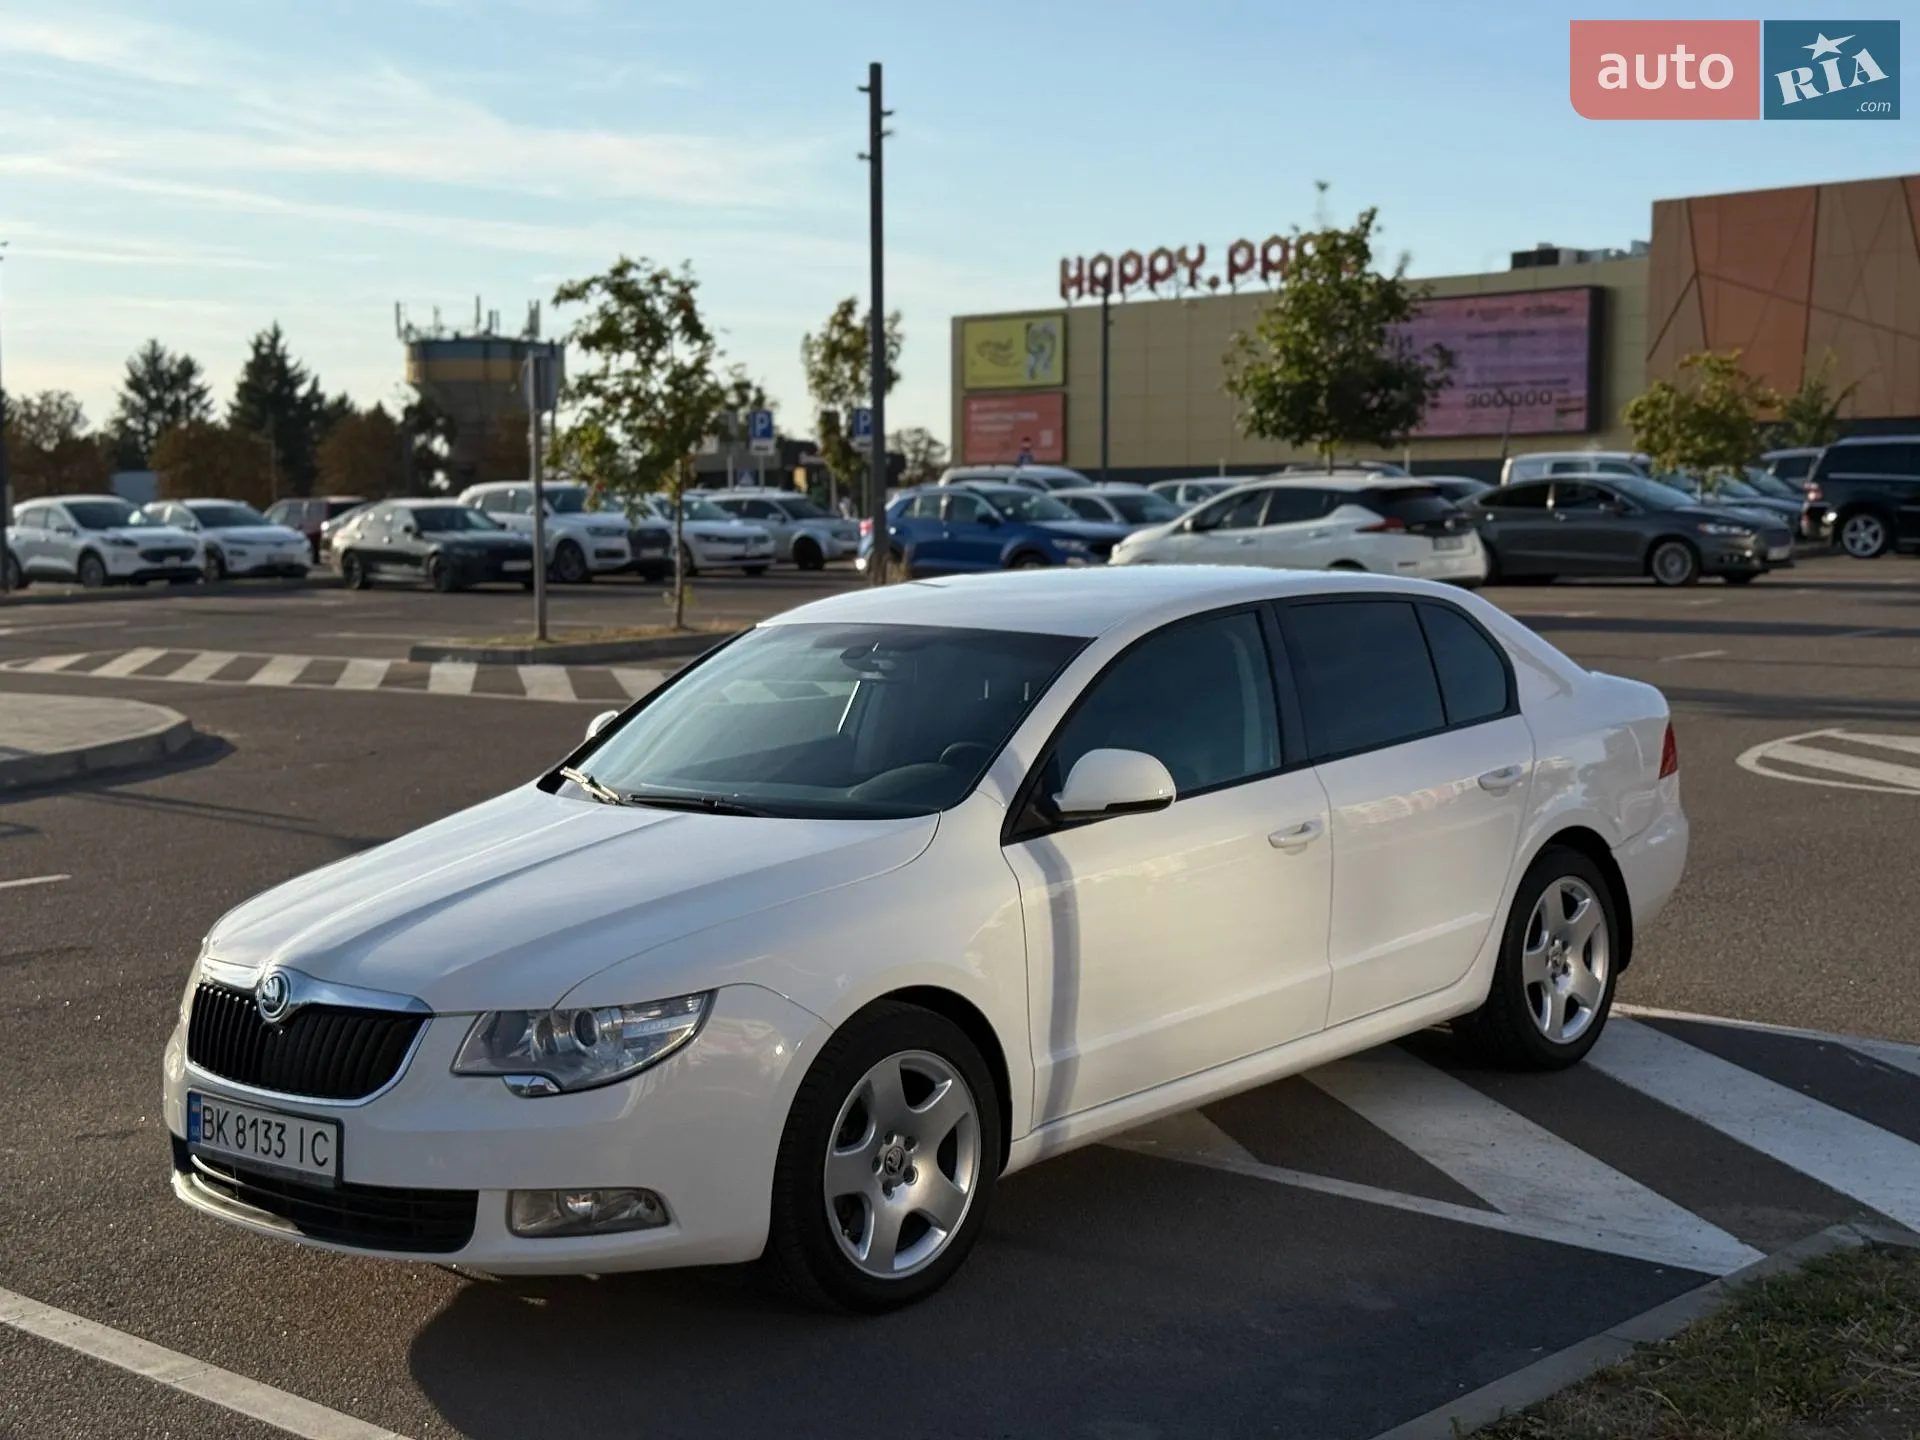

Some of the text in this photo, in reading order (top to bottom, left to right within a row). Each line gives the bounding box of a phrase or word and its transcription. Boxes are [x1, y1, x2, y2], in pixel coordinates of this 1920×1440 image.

[755, 412, 768, 436] P
[202, 1105, 330, 1168] BK 8133 IC
